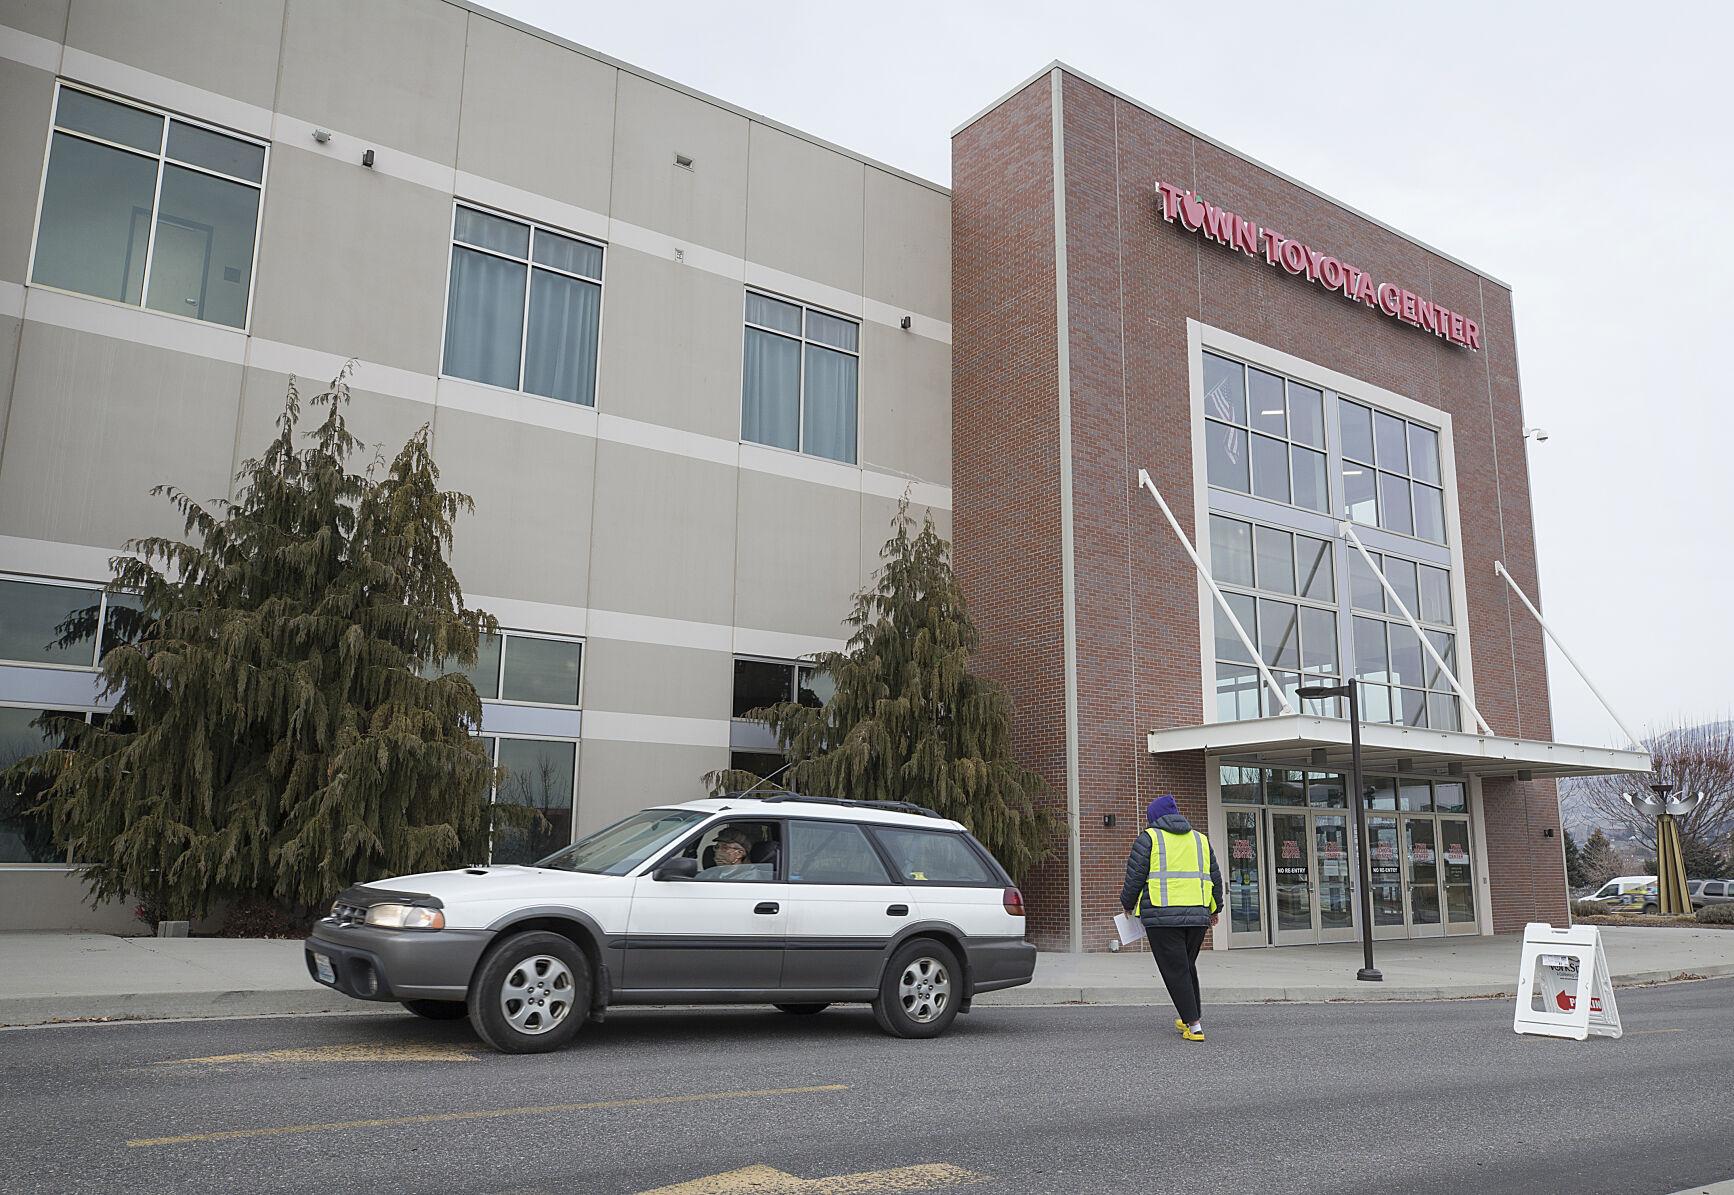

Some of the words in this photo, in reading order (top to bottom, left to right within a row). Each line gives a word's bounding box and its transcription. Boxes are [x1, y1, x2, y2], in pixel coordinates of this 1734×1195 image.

[1155, 181, 1257, 257] TOWN
[1259, 228, 1378, 309] TOYOTA
[1378, 282, 1481, 352] CENTER
